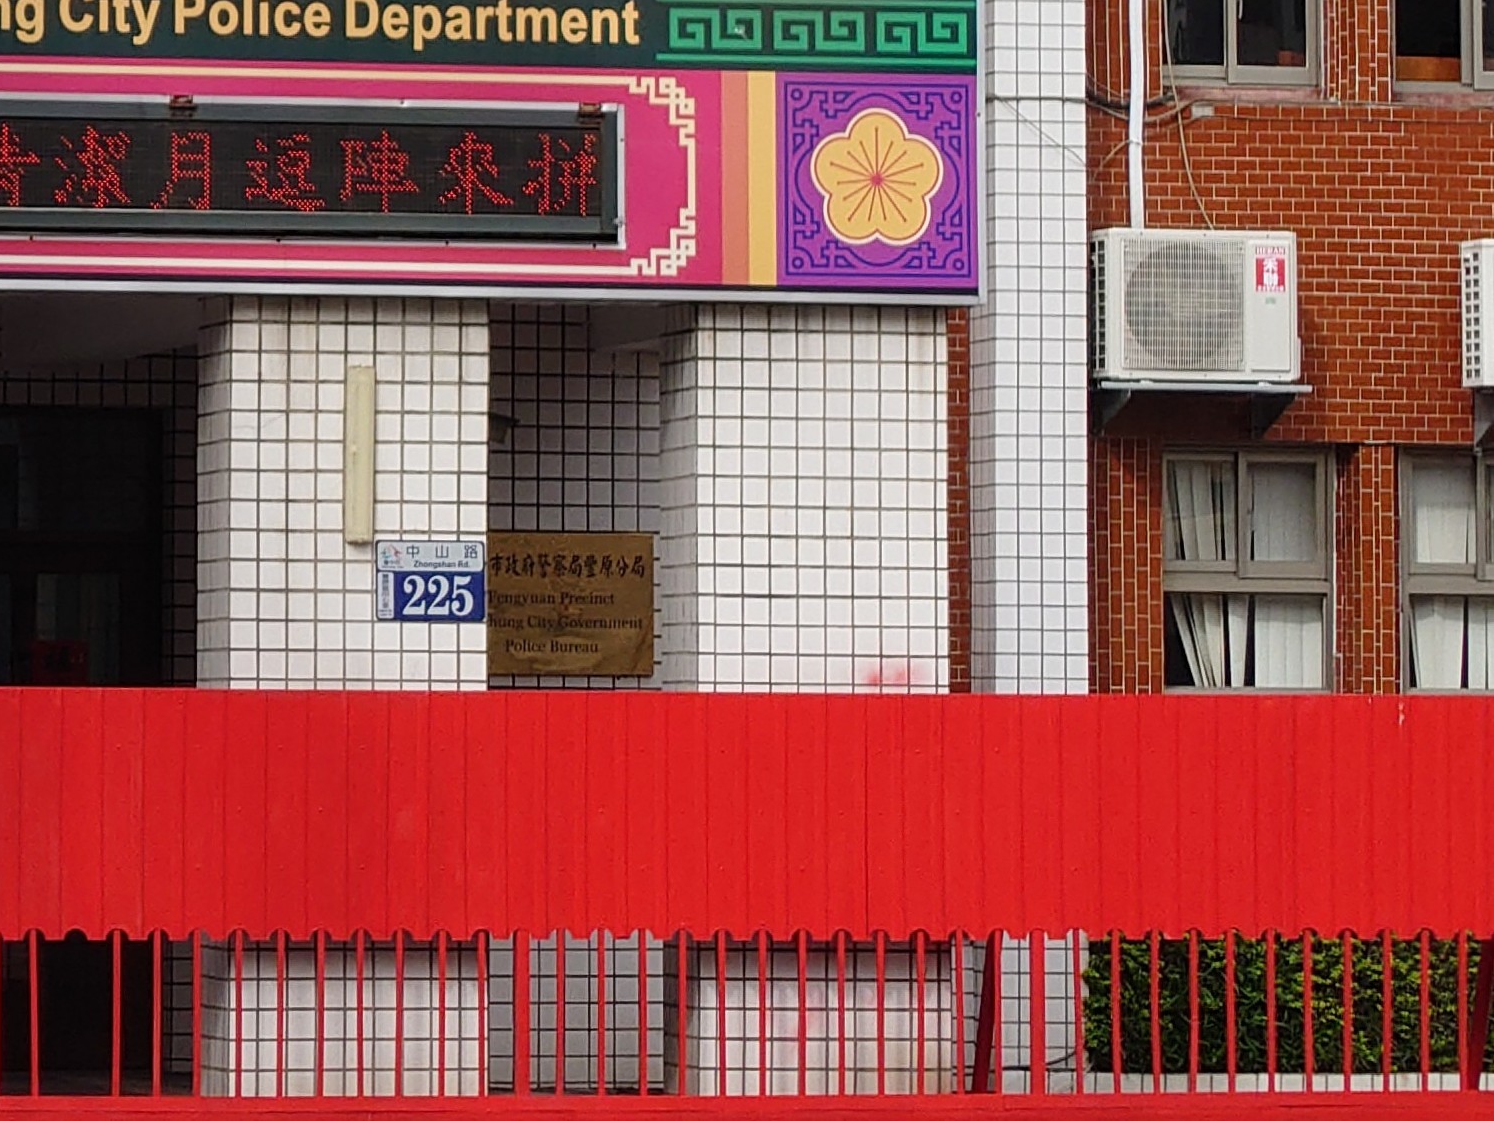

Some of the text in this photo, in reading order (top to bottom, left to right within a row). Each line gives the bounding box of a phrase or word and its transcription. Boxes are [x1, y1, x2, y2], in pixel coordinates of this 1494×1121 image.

[406, 544, 478, 559] 中山路
[413, 560, 456, 569] Zhongshan
[402, 574, 474, 616] 225
[559, 591, 614, 605] Precinct
[527, 614, 554, 632] City
[557, 614, 643, 630] Government
[505, 638, 599, 653] Police Bureau
